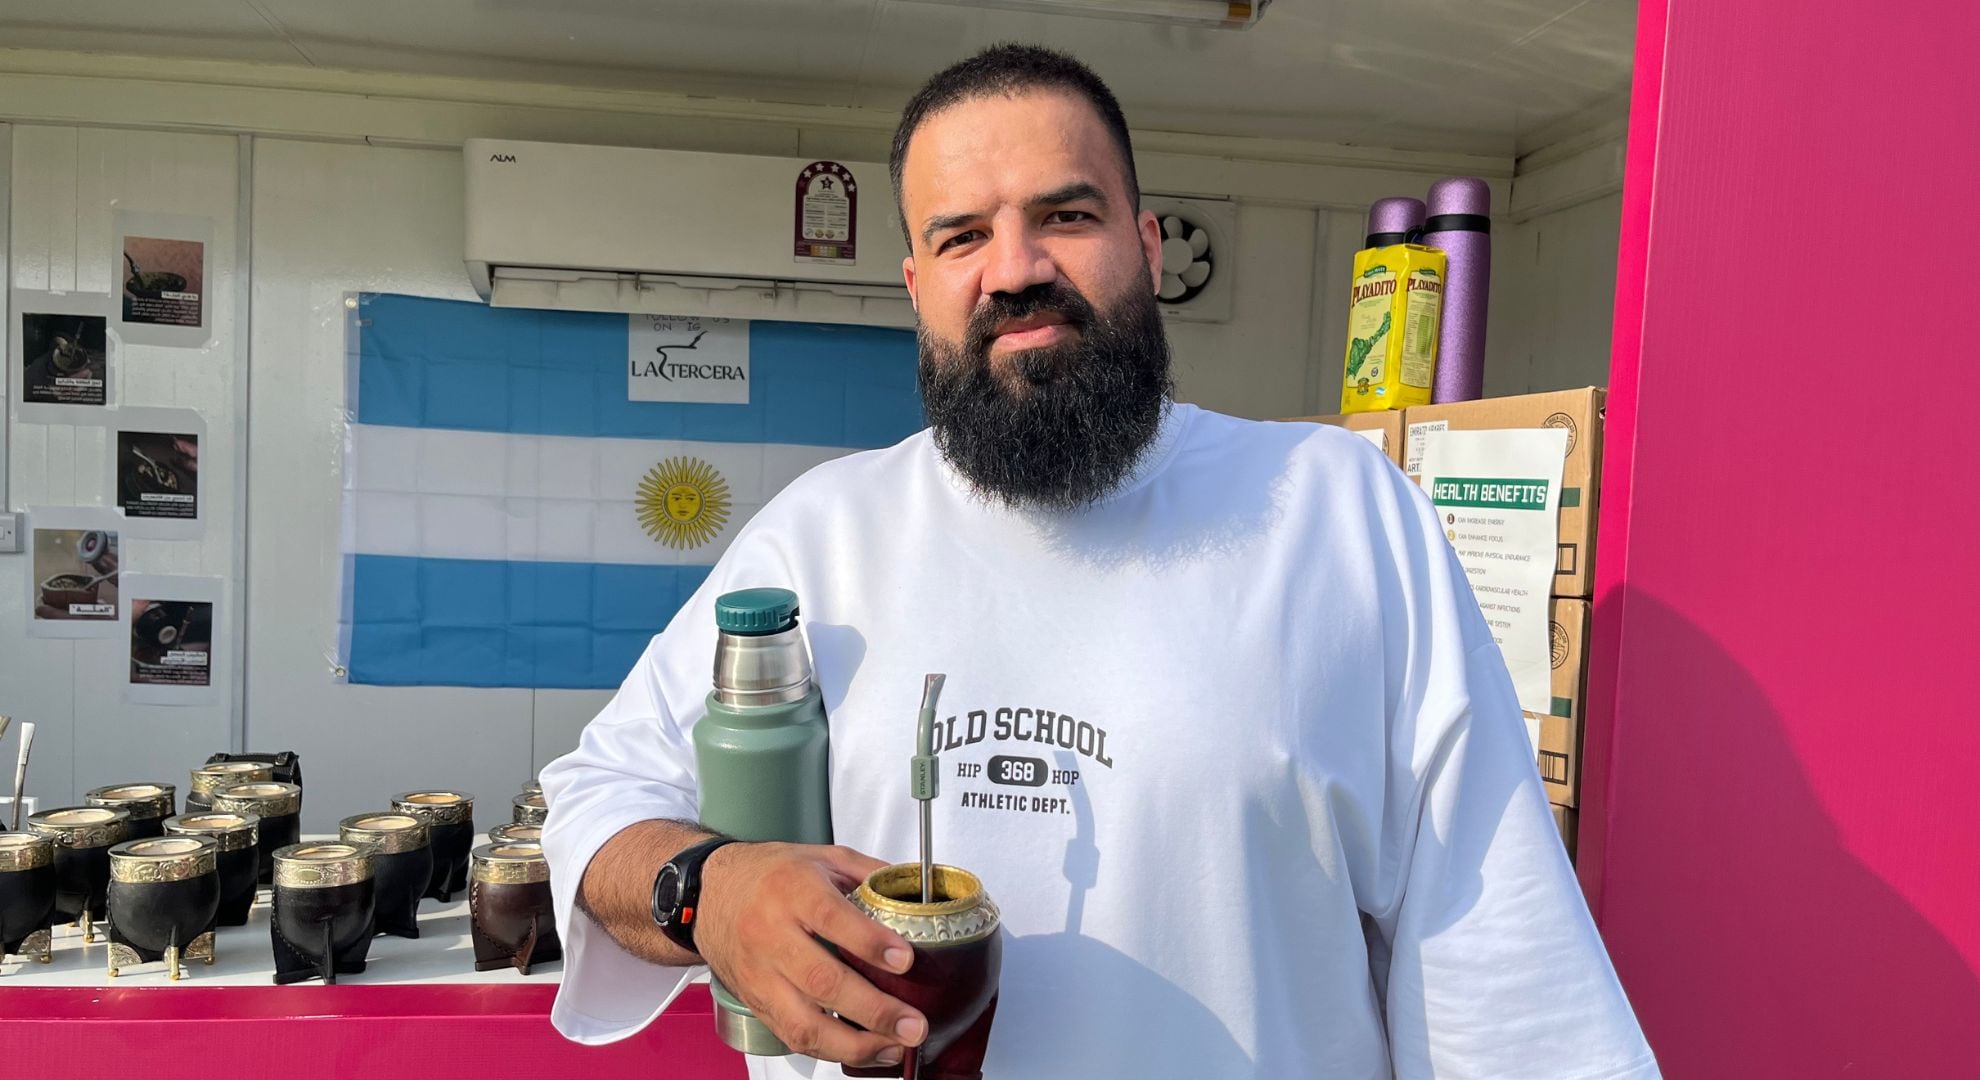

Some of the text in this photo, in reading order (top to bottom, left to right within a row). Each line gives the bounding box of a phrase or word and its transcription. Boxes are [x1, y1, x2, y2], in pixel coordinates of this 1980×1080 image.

[1351, 279, 1397, 308] PLAYADITO
[1406, 278, 1441, 294] PLAYADITO
[653, 321, 701, 332] ON IG
[631, 360, 745, 381] LA TERCERA
[1433, 483, 1547, 504] HEALTH BENEFITS
[1505, 554, 1531, 562] ENDURANCE
[1476, 585, 1511, 596] CARDIOVASCULAR
[1511, 588, 1528, 596] HEALTH
[993, 707, 1113, 769] SCHOOL
[957, 760, 1080, 785] HIP 368 HOP
[961, 791, 1070, 815] ATHLETIC DEPT.
